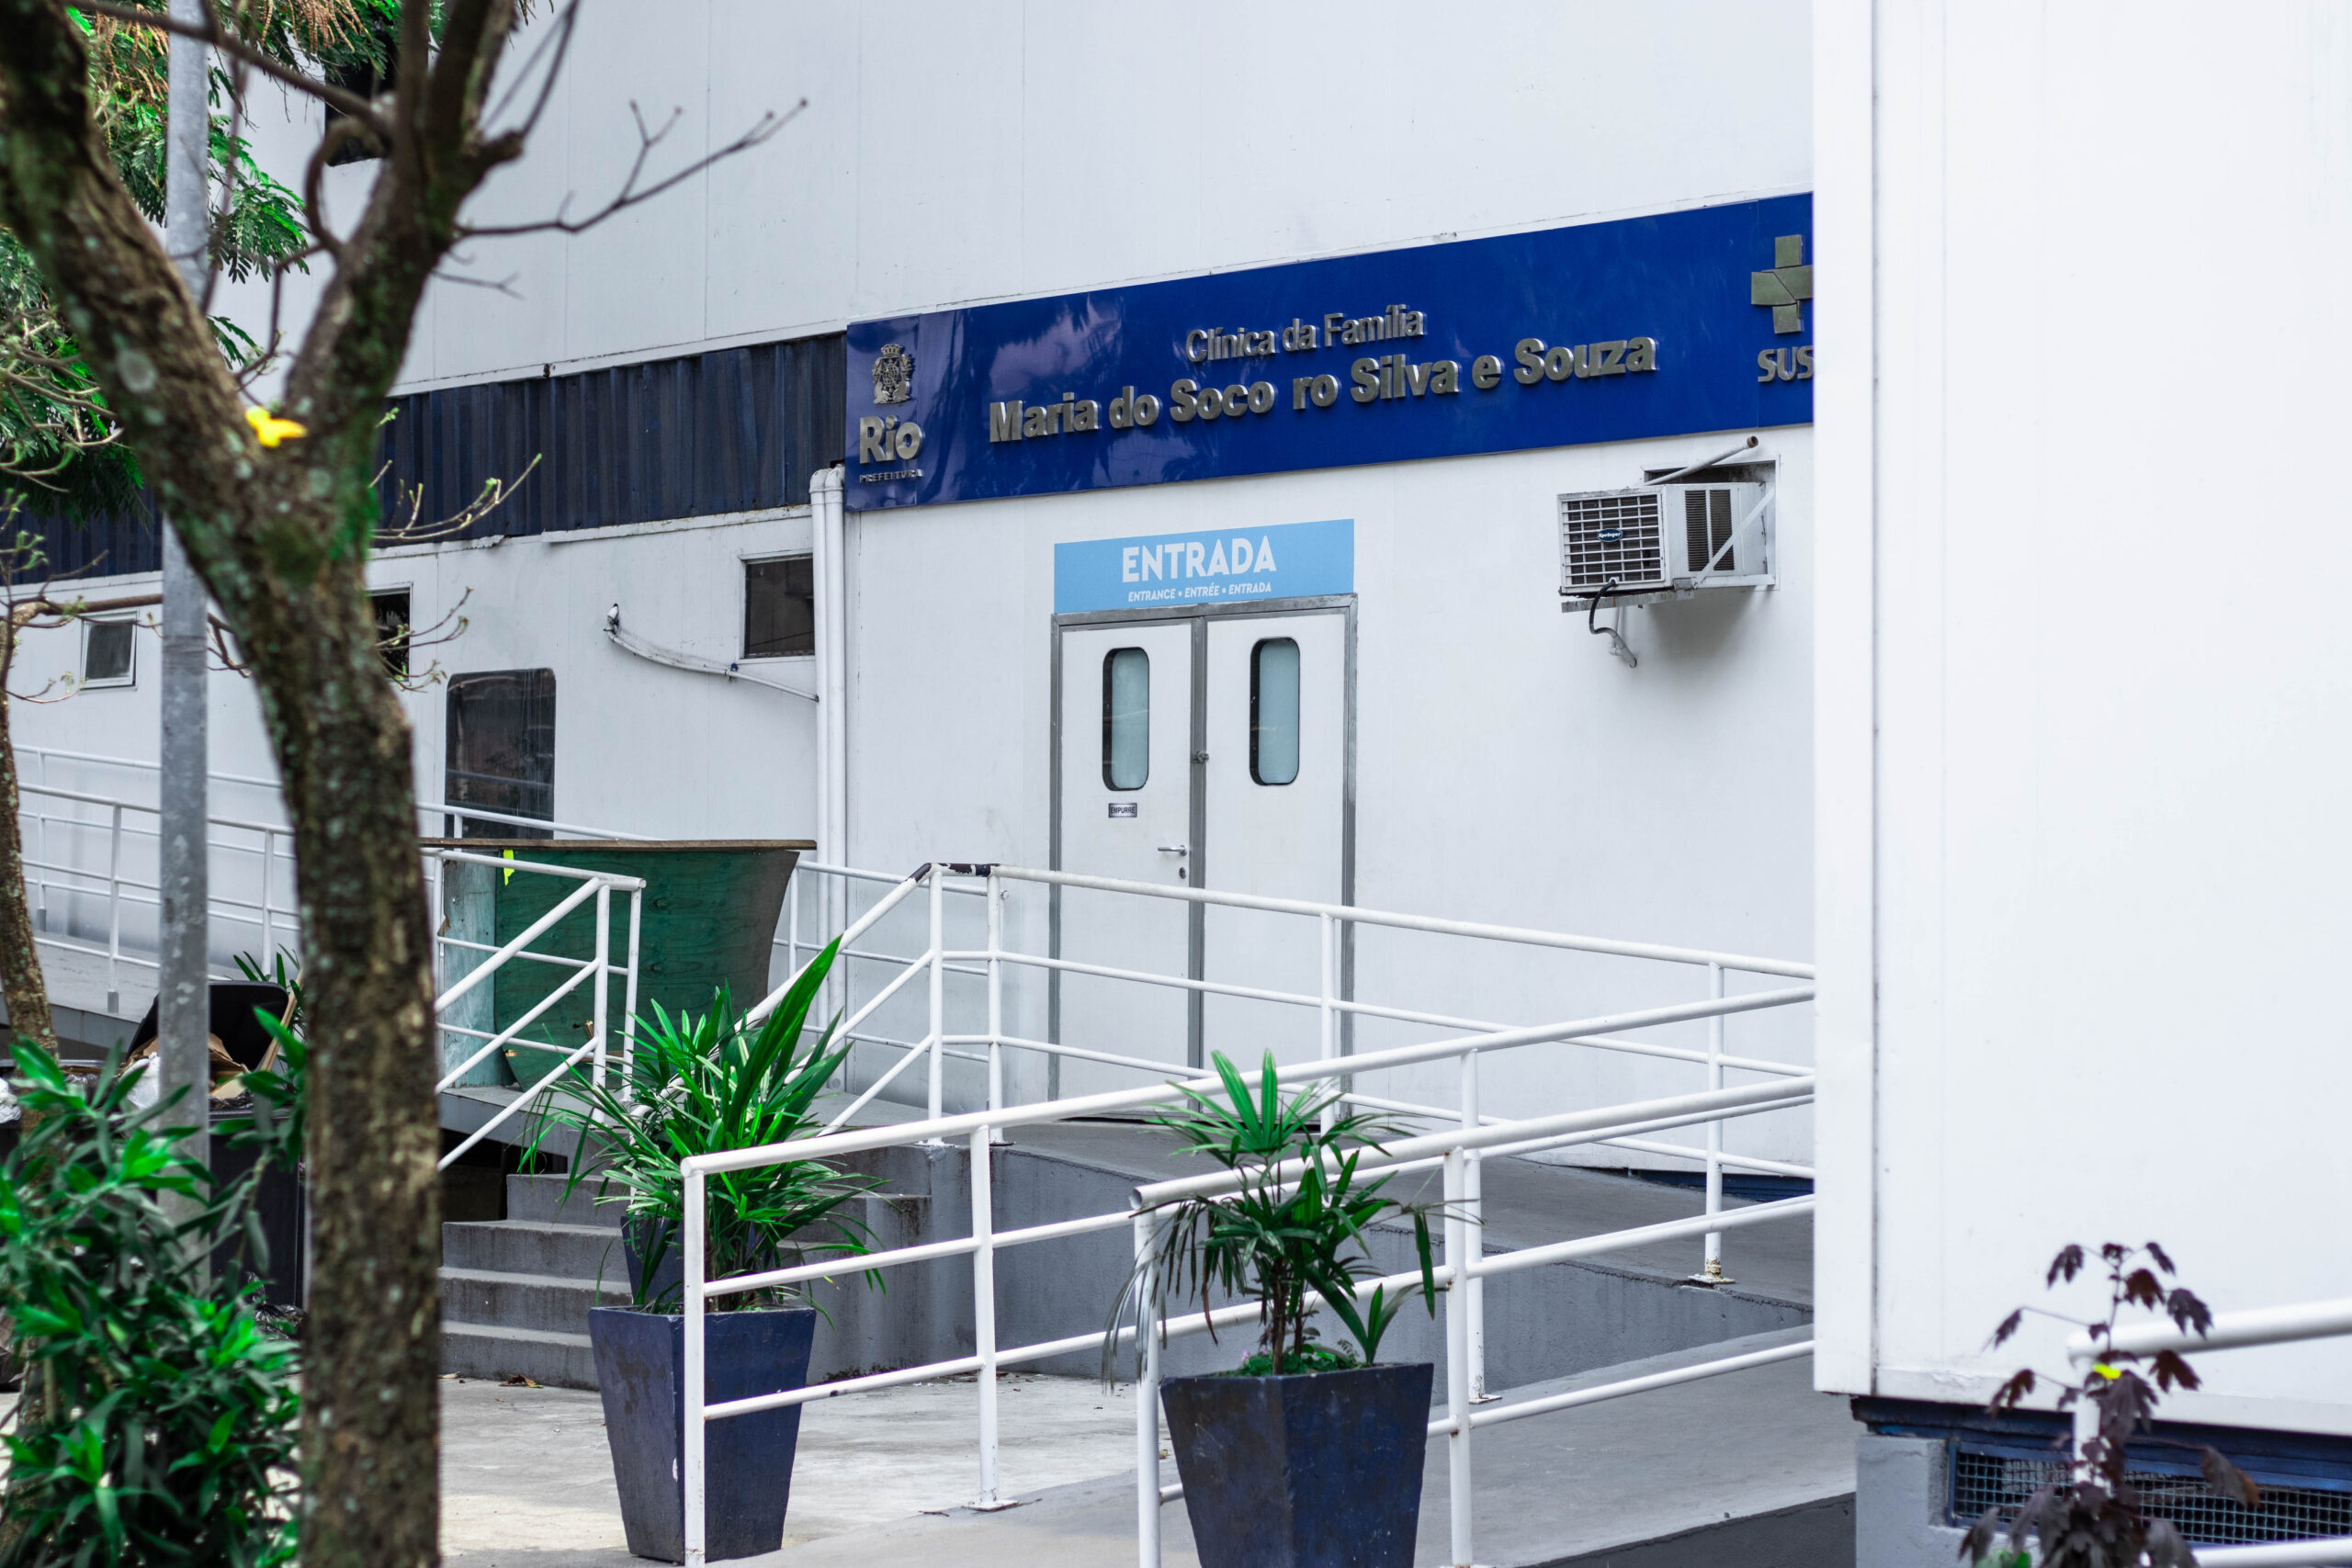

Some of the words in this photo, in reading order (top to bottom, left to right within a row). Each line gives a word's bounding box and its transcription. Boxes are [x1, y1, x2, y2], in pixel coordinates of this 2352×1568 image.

[1185, 326, 1277, 363] Clínica
[1283, 318, 1318, 352] da
[1324, 304, 1426, 347] Família
[1758, 345, 1813, 382] SUS
[989, 392, 1101, 443] Maria
[1109, 386, 1160, 429] do
[1351, 354, 1462, 403] Silva
[1473, 355, 1502, 389] e
[1513, 336, 1657, 385] Souza
[860, 414, 923, 464] Rio
[1122, 536, 1277, 583] ENTRADA
[1128, 589, 1176, 603] ENTRANCE
[1184, 582, 1220, 598] ENTRÉE
[1228, 581, 1272, 595] ENTRADA
